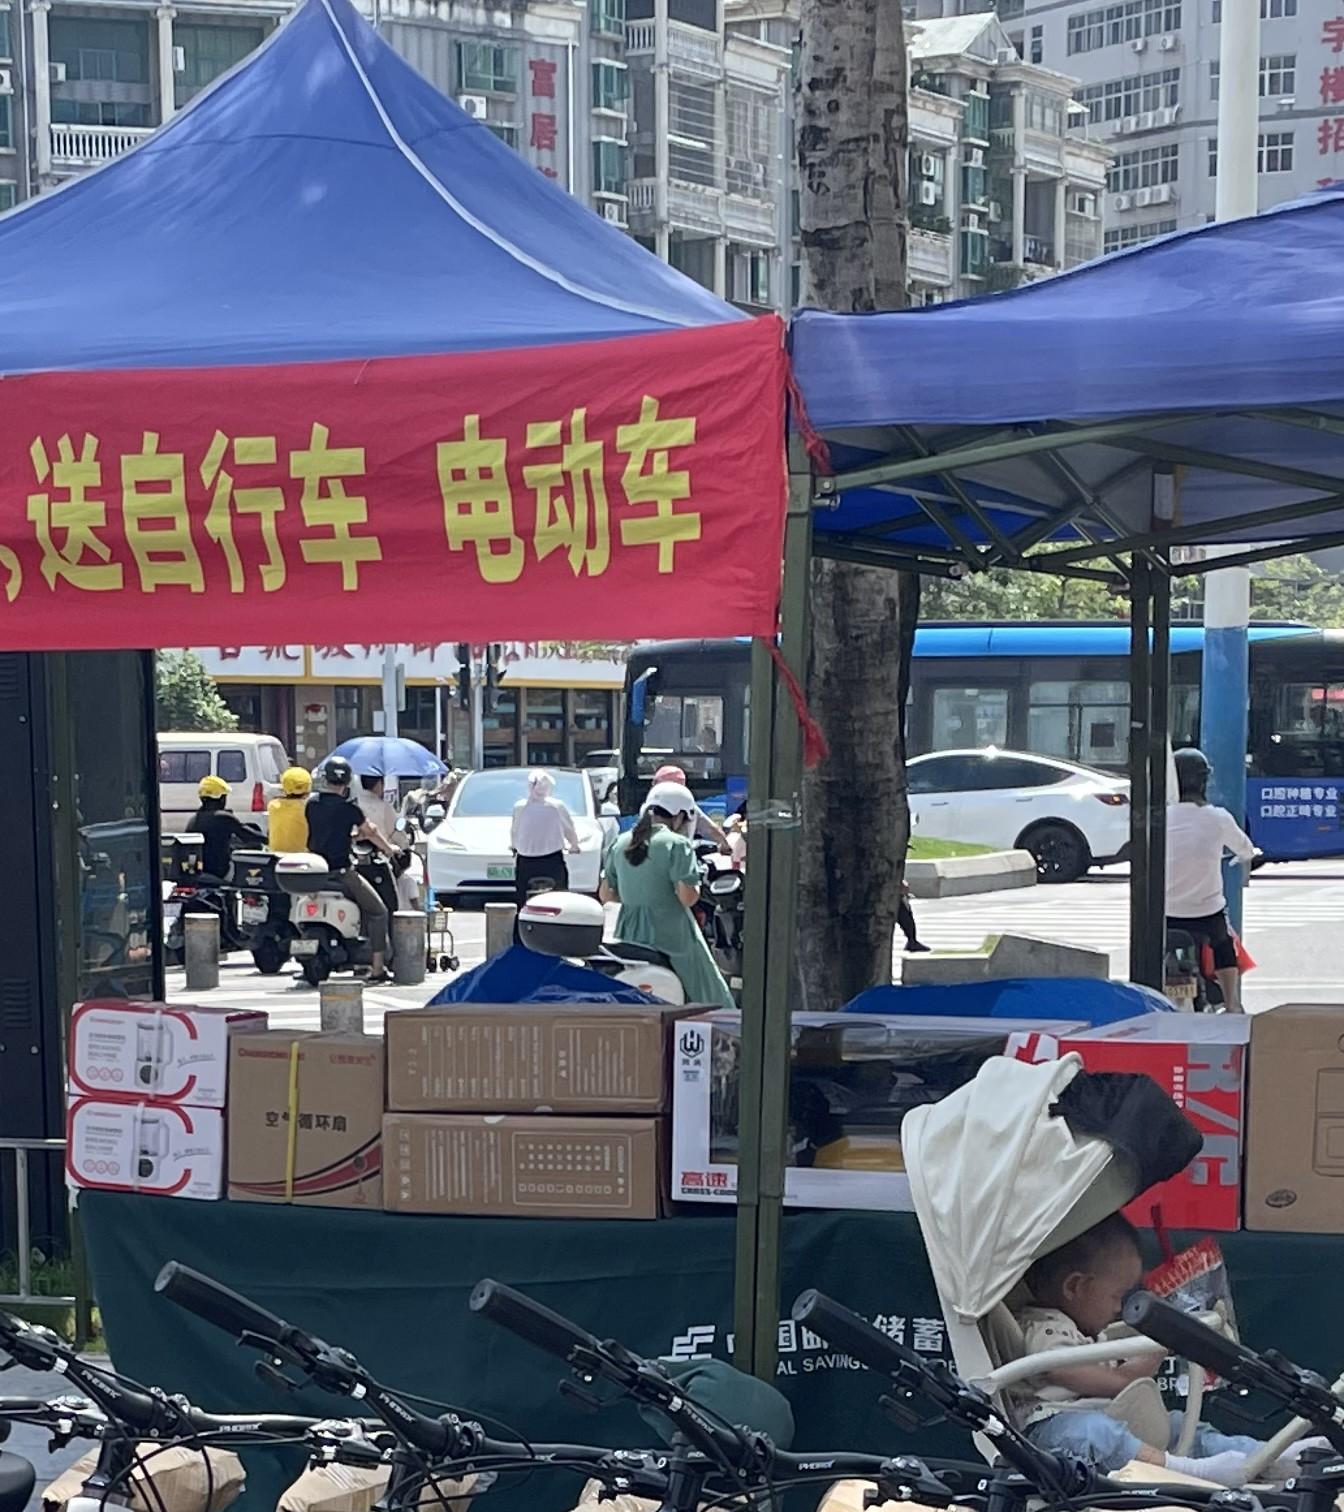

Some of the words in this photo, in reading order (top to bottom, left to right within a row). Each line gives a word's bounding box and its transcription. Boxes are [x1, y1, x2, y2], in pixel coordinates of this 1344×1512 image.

[436, 396, 704, 585] 电动车
[681, 1171, 728, 1188] 高速
